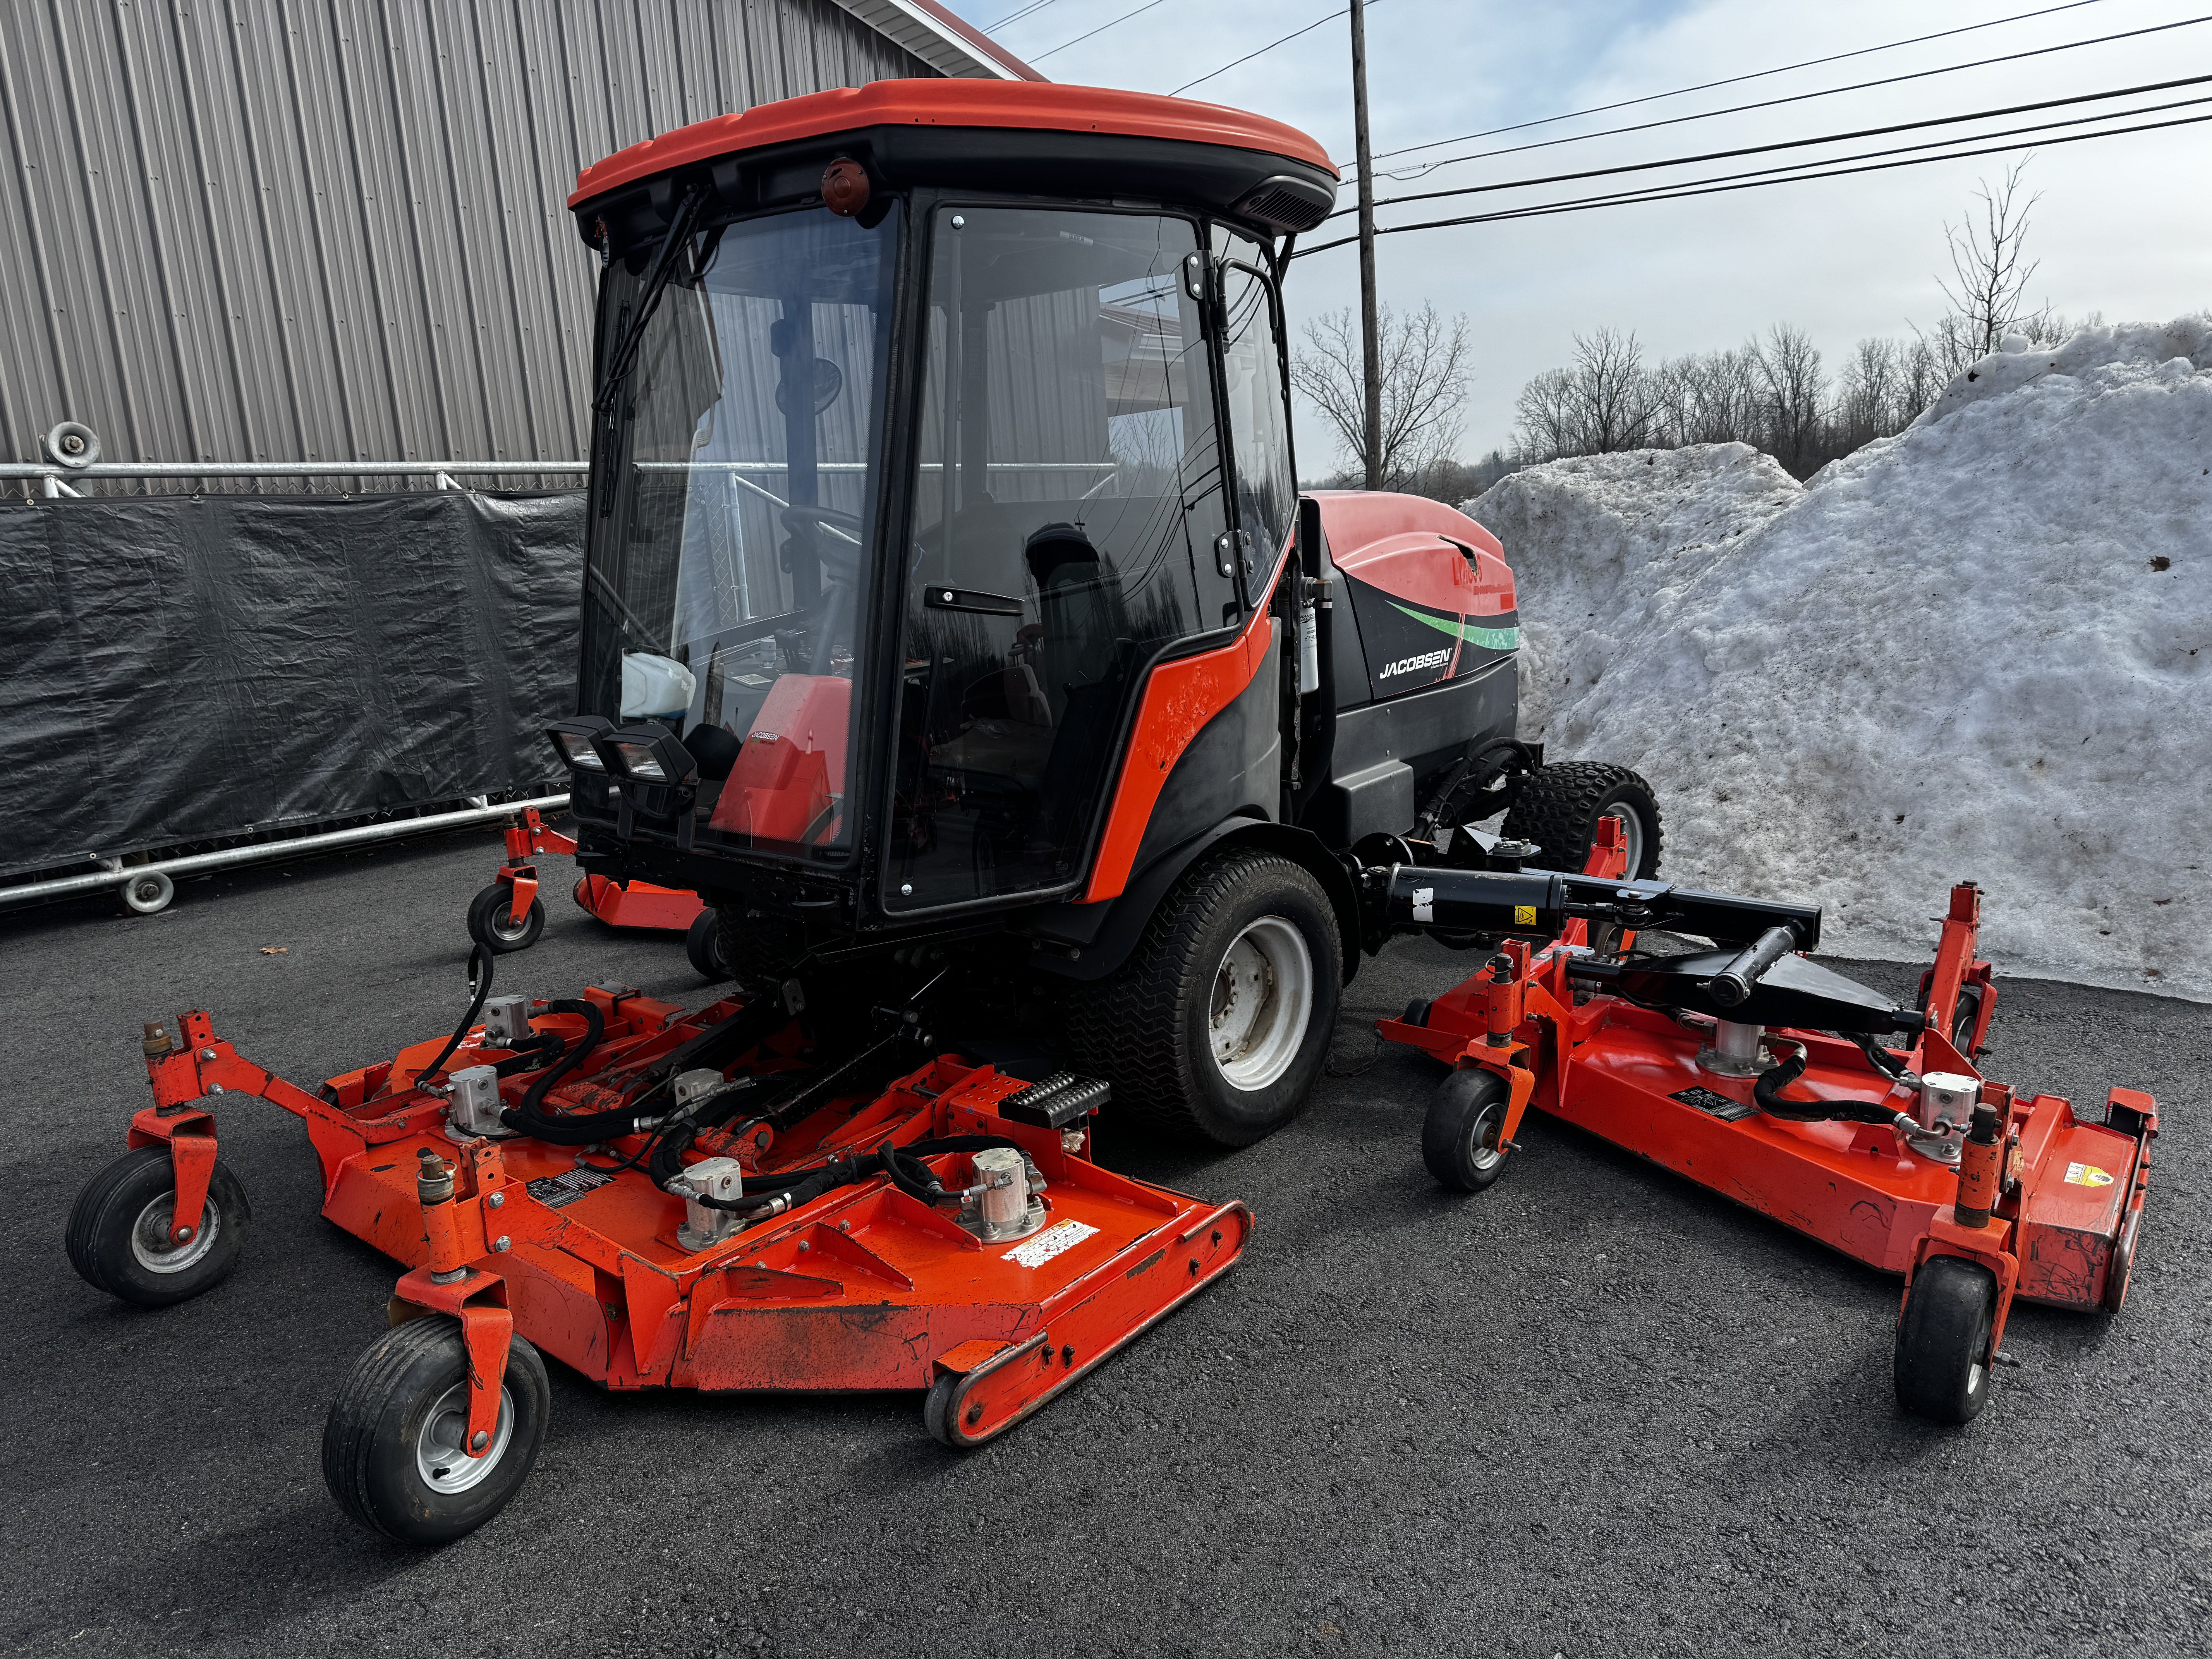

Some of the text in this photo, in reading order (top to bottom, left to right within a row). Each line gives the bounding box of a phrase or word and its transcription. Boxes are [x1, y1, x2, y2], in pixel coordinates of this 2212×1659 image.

[1379, 647, 1451, 679] JACOBSEN
[752, 731, 780, 741] JACOBSEN
[1031, 1225, 1062, 1243] DANGER
